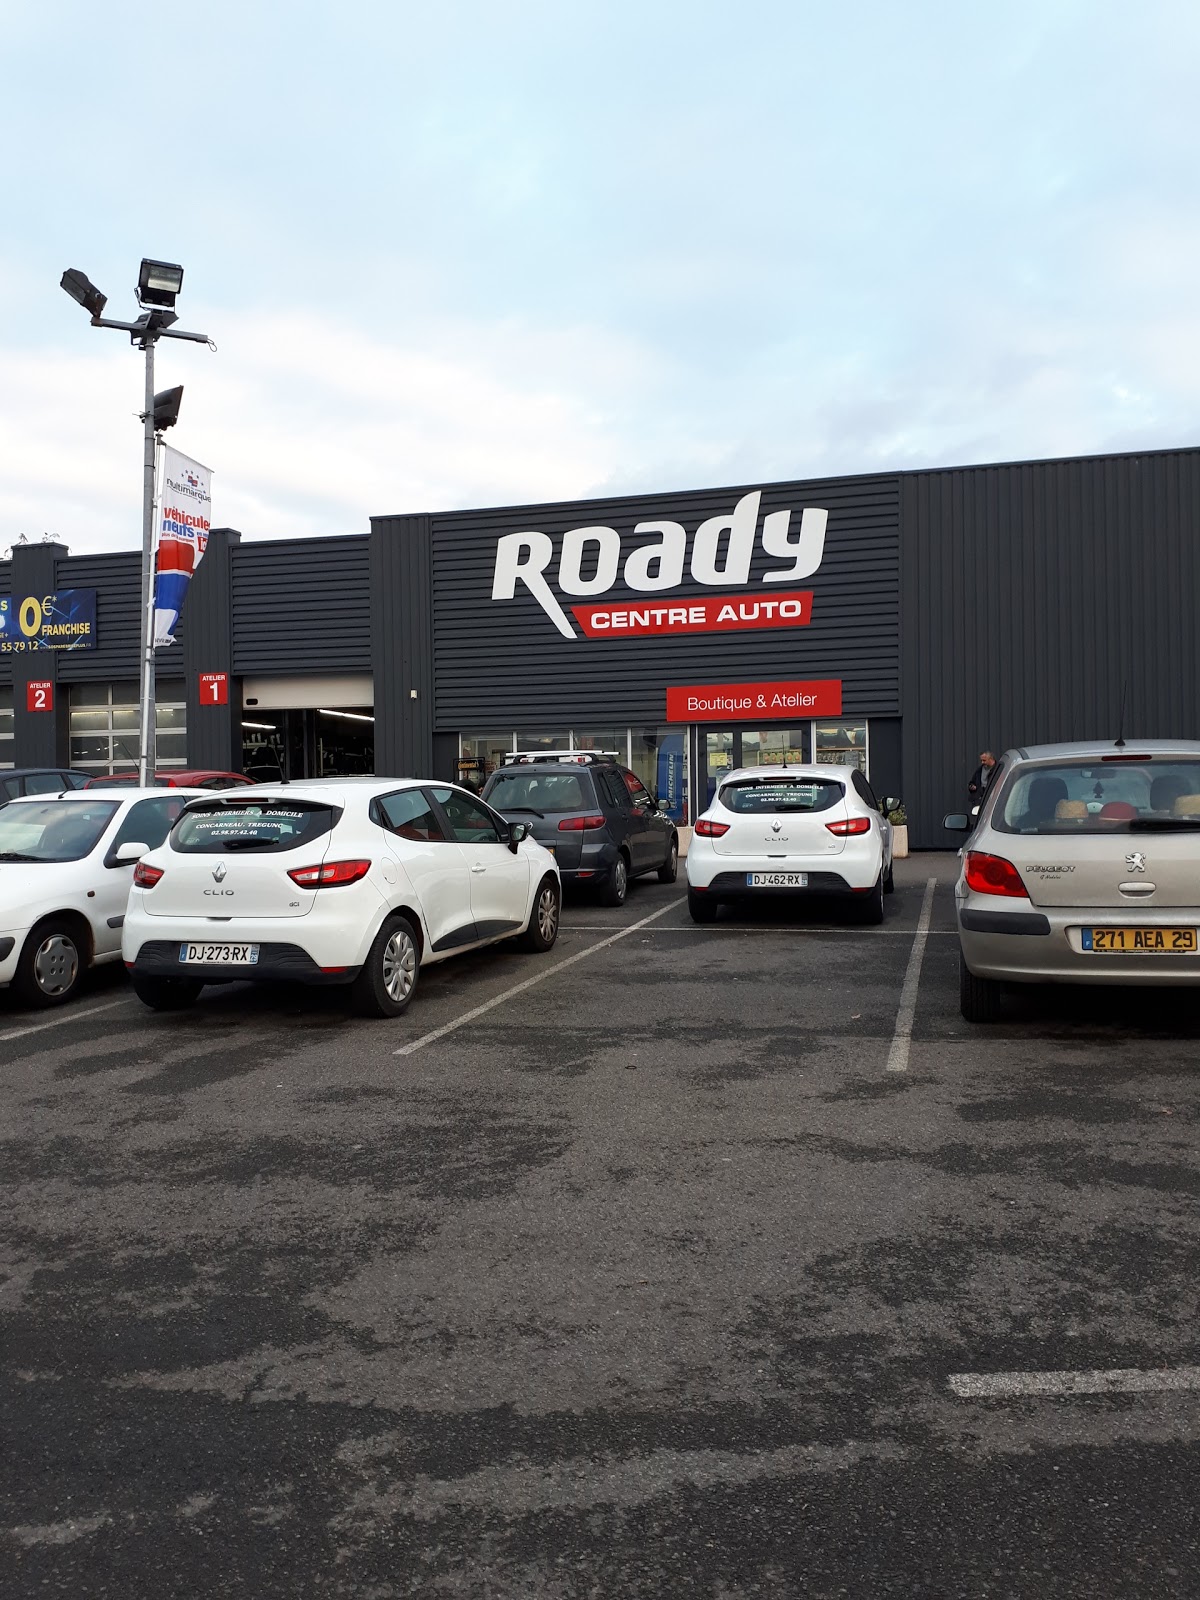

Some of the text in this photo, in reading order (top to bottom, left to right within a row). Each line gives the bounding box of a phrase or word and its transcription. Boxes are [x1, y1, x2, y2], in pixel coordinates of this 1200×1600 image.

[164, 506, 210, 530] véhicule
[492, 490, 828, 638] Roady
[590, 600, 802, 630] CENTRE AUTO
[42, 622, 90, 636] FRANCHISE
[2, 642, 12, 652] 55
[14, 642, 26, 650] 79
[28, 641, 38, 650] 12
[34, 690, 46, 708] 2
[210, 682, 218, 700] 1
[688, 692, 818, 712] Boutique & Atelier
[192, 812, 212, 820] SOINS
[1095, 931, 1125, 948] 271
[1134, 931, 1164, 948] AEA
[1172, 931, 1193, 948] 29
[188, 946, 249, 961] DJ-273-RX
